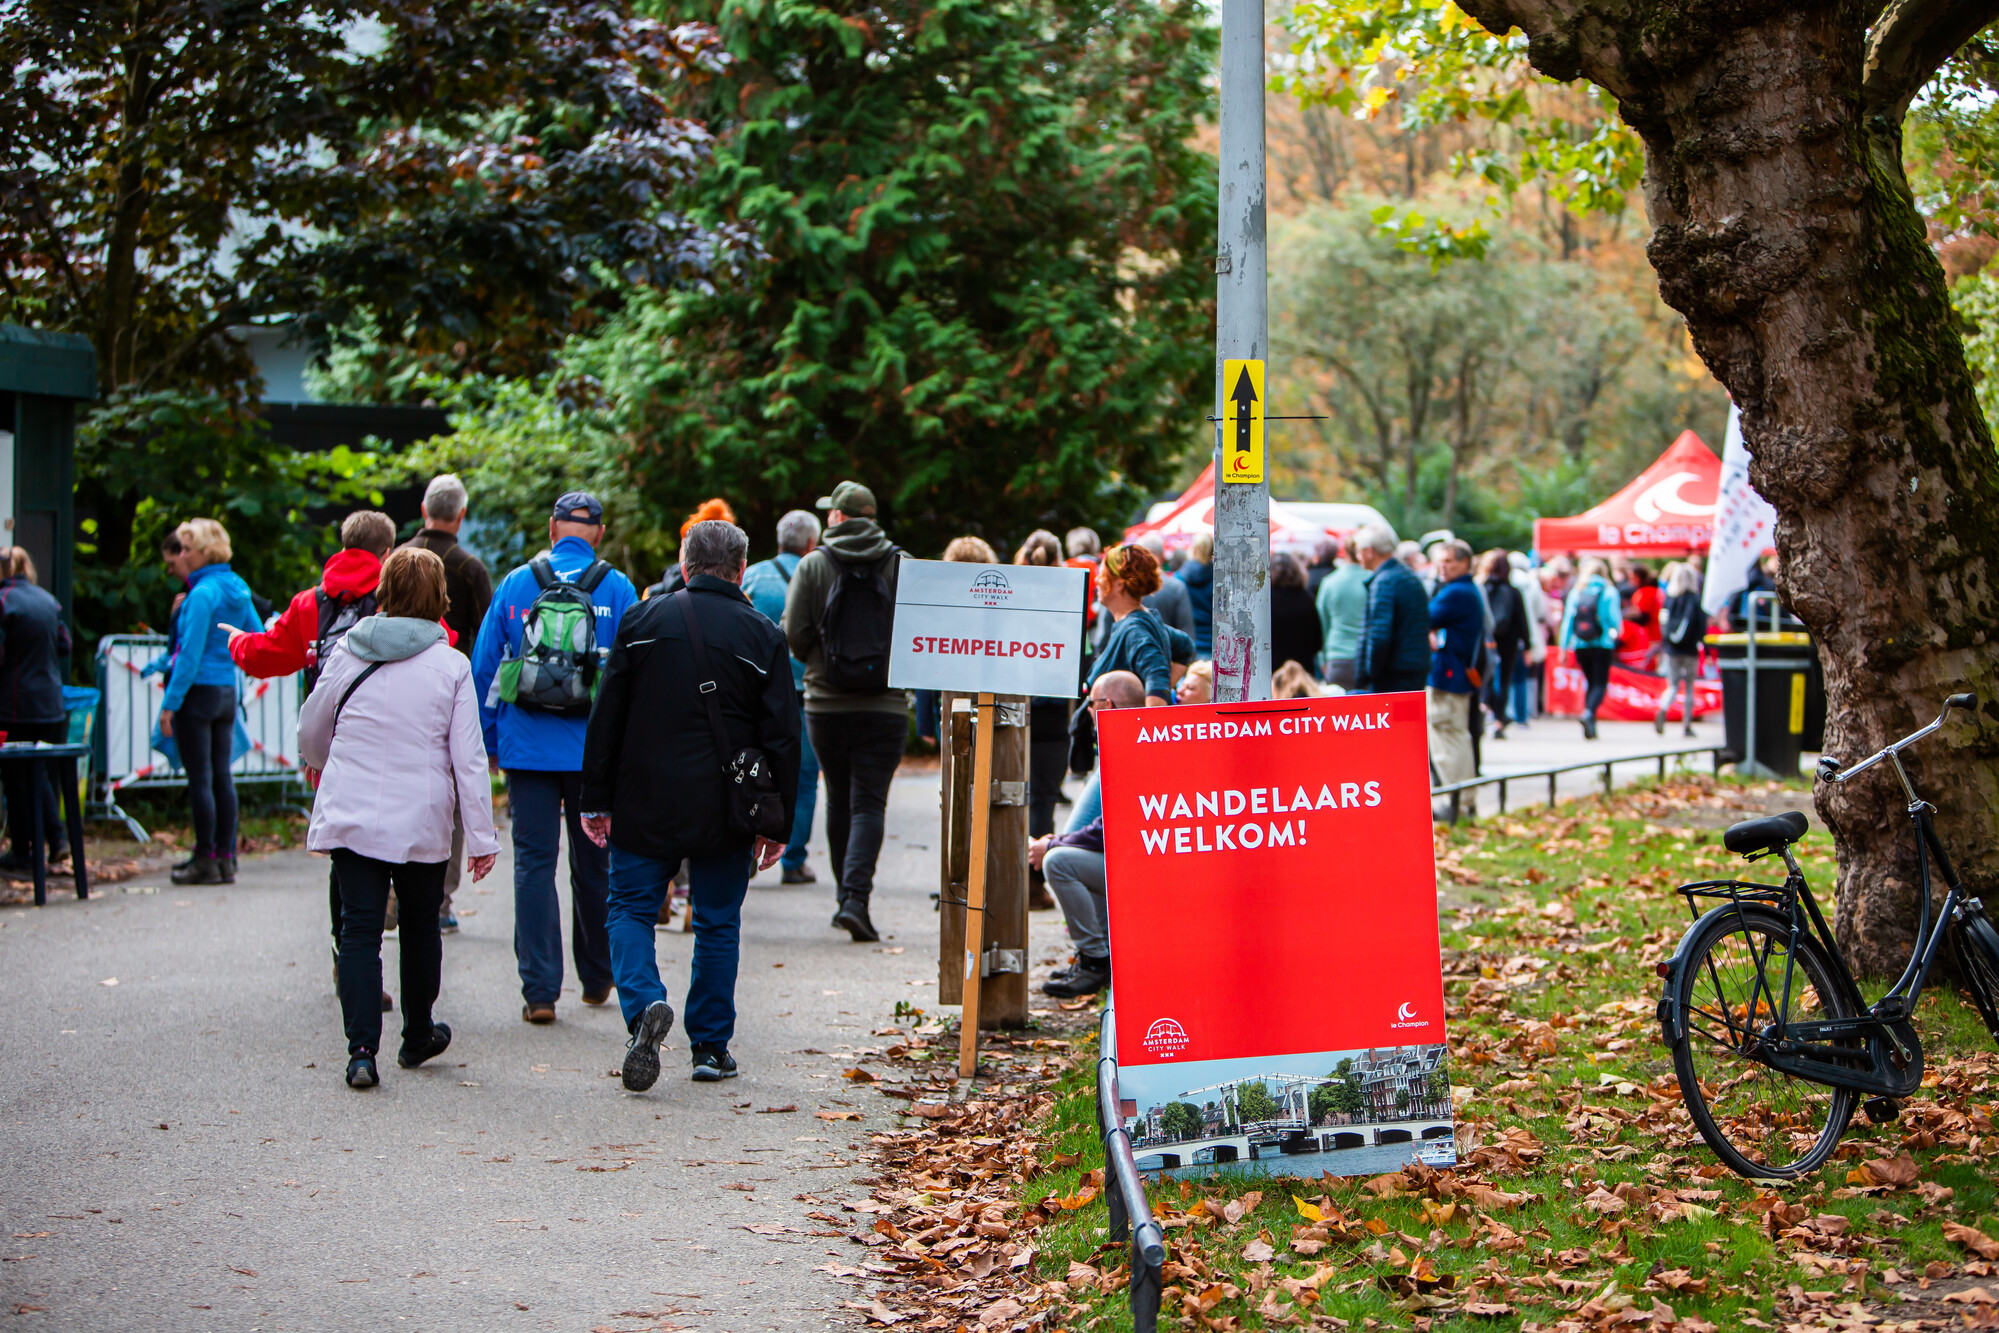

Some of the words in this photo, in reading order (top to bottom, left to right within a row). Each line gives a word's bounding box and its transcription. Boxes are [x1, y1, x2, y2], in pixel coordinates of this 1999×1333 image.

[912, 636, 1065, 660] STEMPELPOST
[1136, 718, 1273, 744] AMSTERDAM
[1278, 715, 1326, 735] CITY
[1331, 712, 1391, 732] WALK
[1138, 780, 1382, 821] WANDELAARS
[1140, 819, 1307, 856] WELKOM!
[1142, 1038, 1190, 1046] AMSTERDAM
